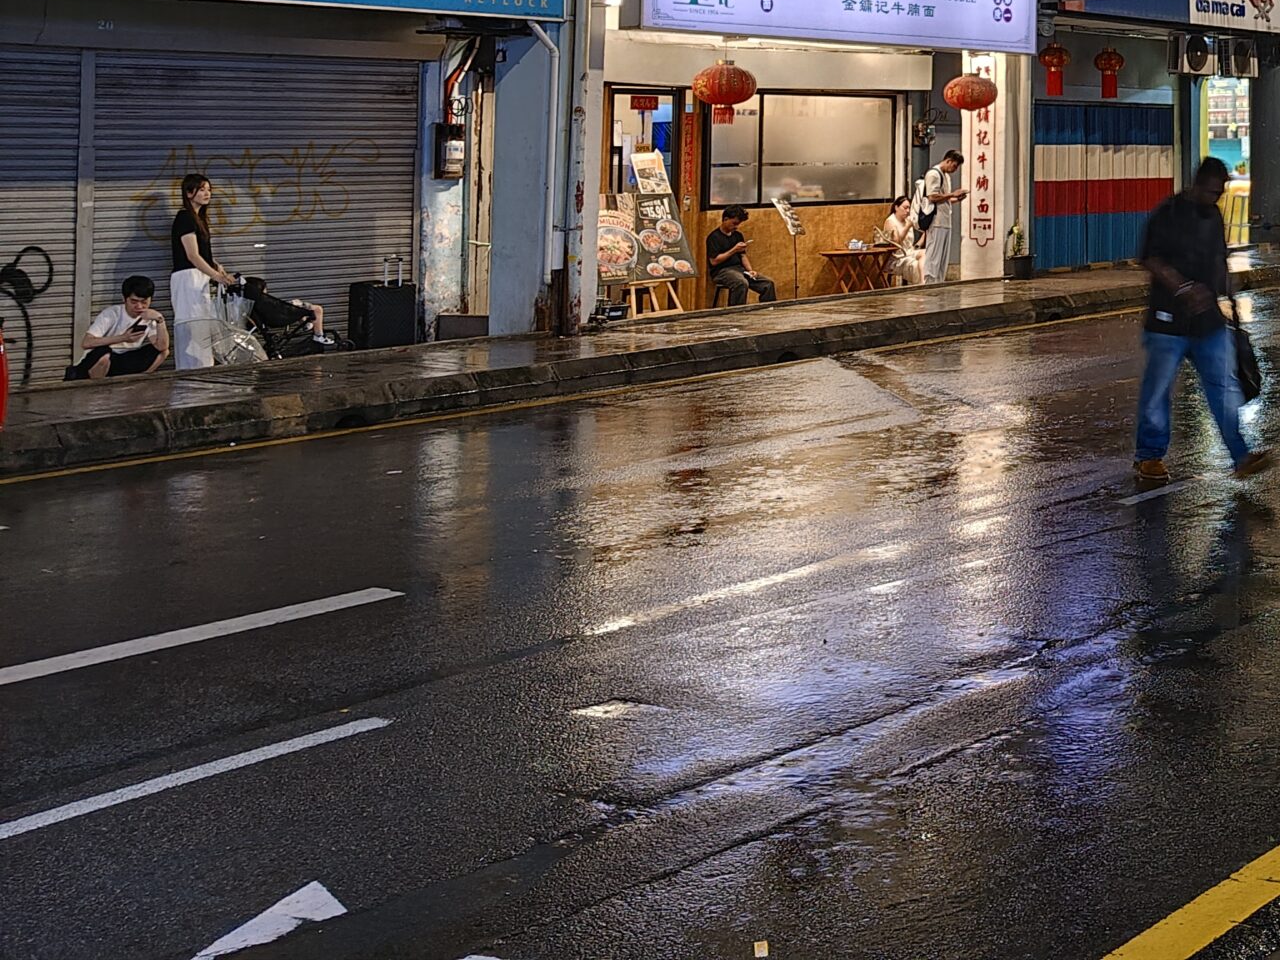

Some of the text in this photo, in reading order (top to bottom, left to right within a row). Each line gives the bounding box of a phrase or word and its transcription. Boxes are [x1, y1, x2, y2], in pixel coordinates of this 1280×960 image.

[1211, 1, 1229, 14] ma
[1230, 0, 1246, 17] cai
[97, 19, 114, 31] 20
[599, 217, 631, 231] MILLION
